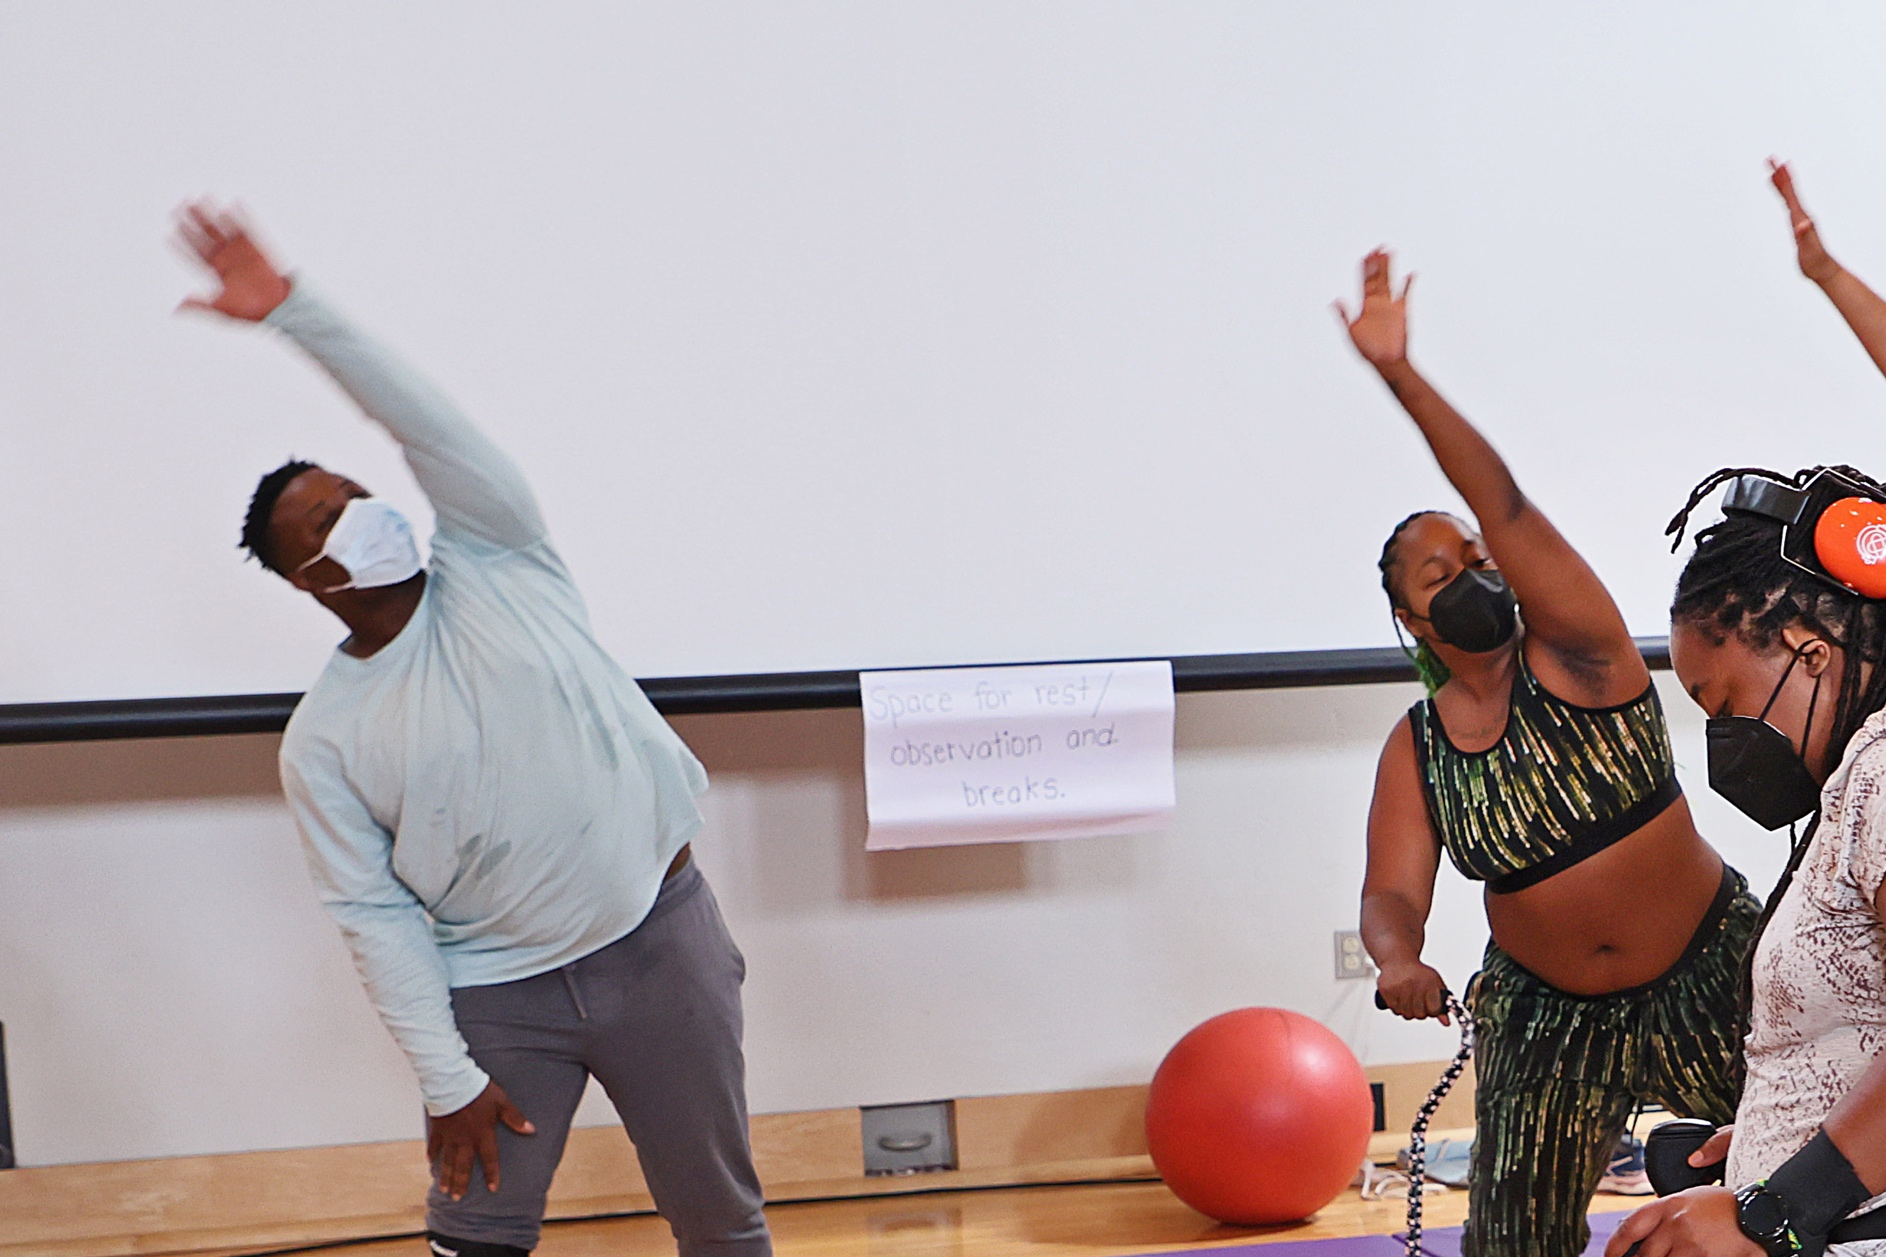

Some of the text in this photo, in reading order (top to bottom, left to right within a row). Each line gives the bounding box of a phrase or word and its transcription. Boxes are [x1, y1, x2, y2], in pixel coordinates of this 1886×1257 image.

[868, 684, 953, 729] Space
[973, 680, 1013, 712] for
[889, 730, 1043, 767] observation
[960, 775, 1067, 808] breaks.
